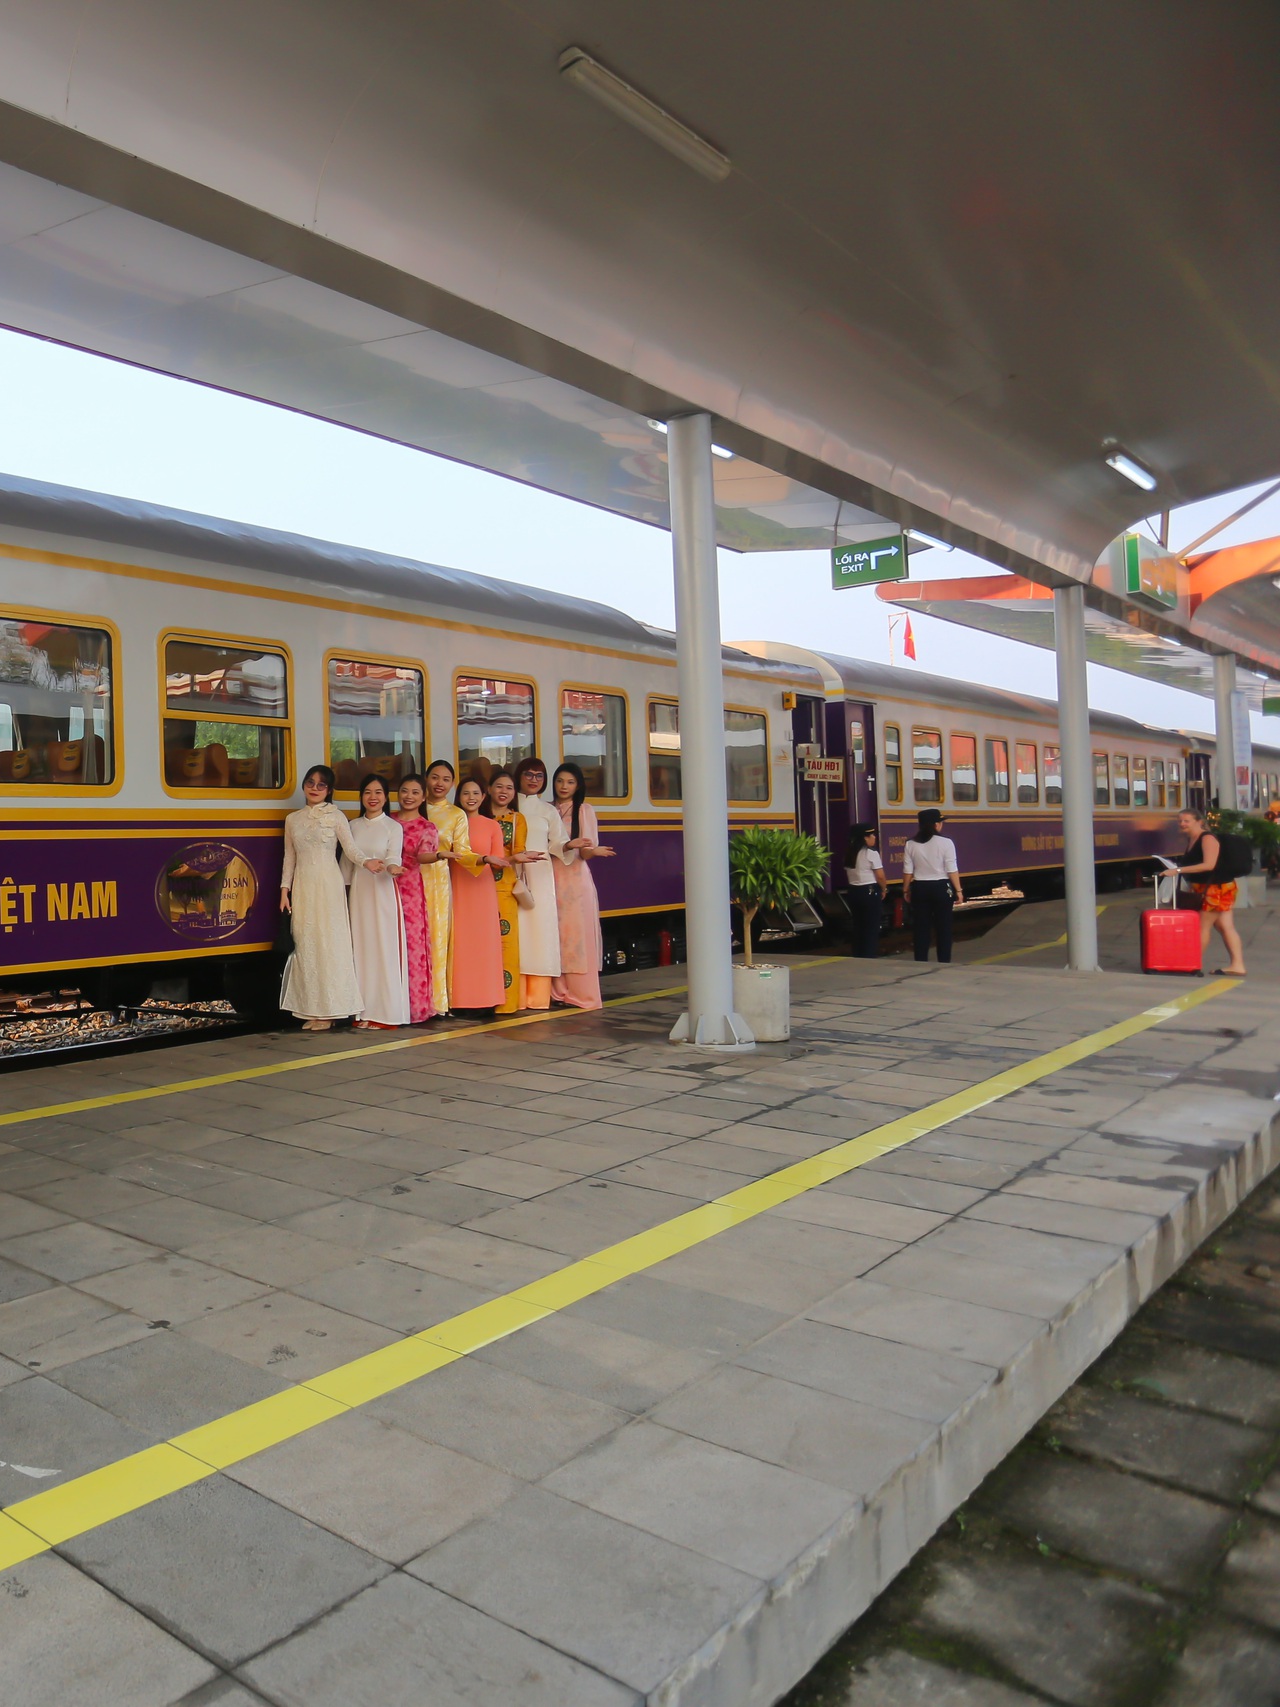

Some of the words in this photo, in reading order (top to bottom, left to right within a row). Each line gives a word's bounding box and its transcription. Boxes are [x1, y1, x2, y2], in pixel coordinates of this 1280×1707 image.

[854, 552, 869, 562] RA
[841, 563, 864, 574] EXIT
[806, 746, 811, 755] 1
[233, 874, 249, 889] SẢN
[46, 880, 118, 922] NAM
